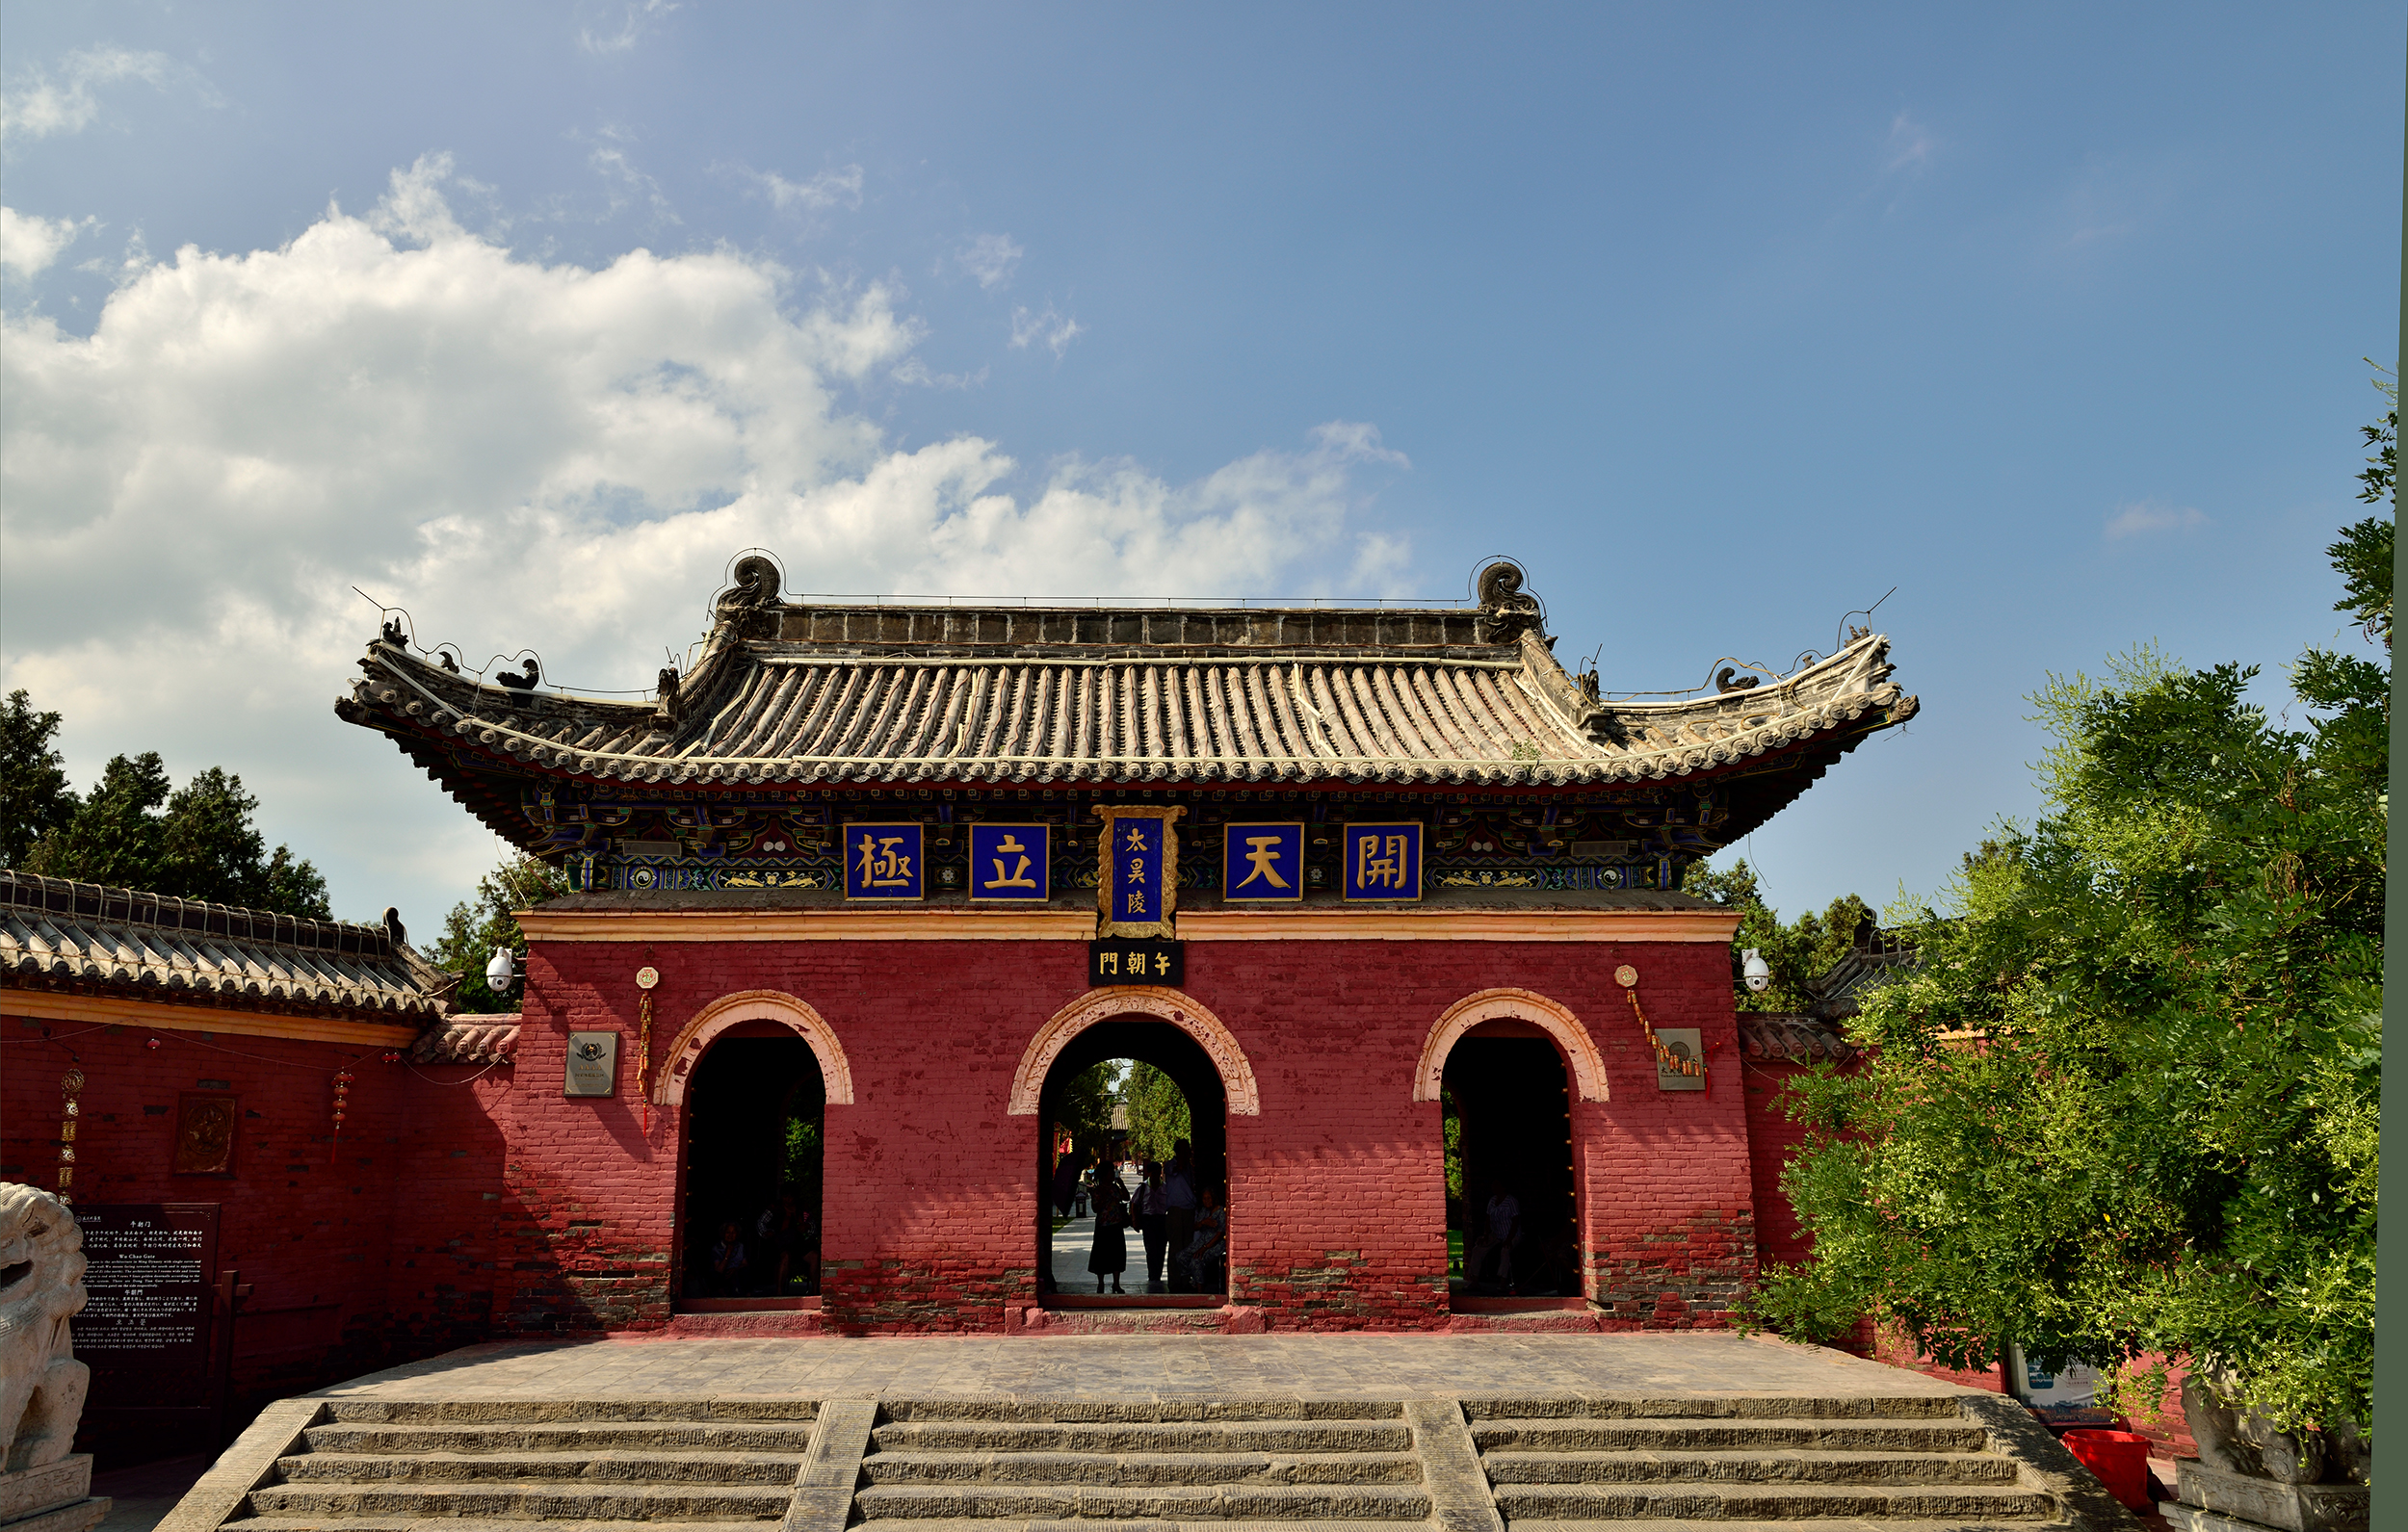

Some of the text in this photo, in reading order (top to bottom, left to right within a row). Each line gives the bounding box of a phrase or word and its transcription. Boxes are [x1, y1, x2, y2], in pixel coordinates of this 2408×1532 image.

[855, 833, 913, 889] 極
[983, 834, 1036, 889] 立
[1125, 827, 1148, 914] 太昊陵
[1236, 836, 1292, 889] 天
[1356, 834, 1408, 890] 開
